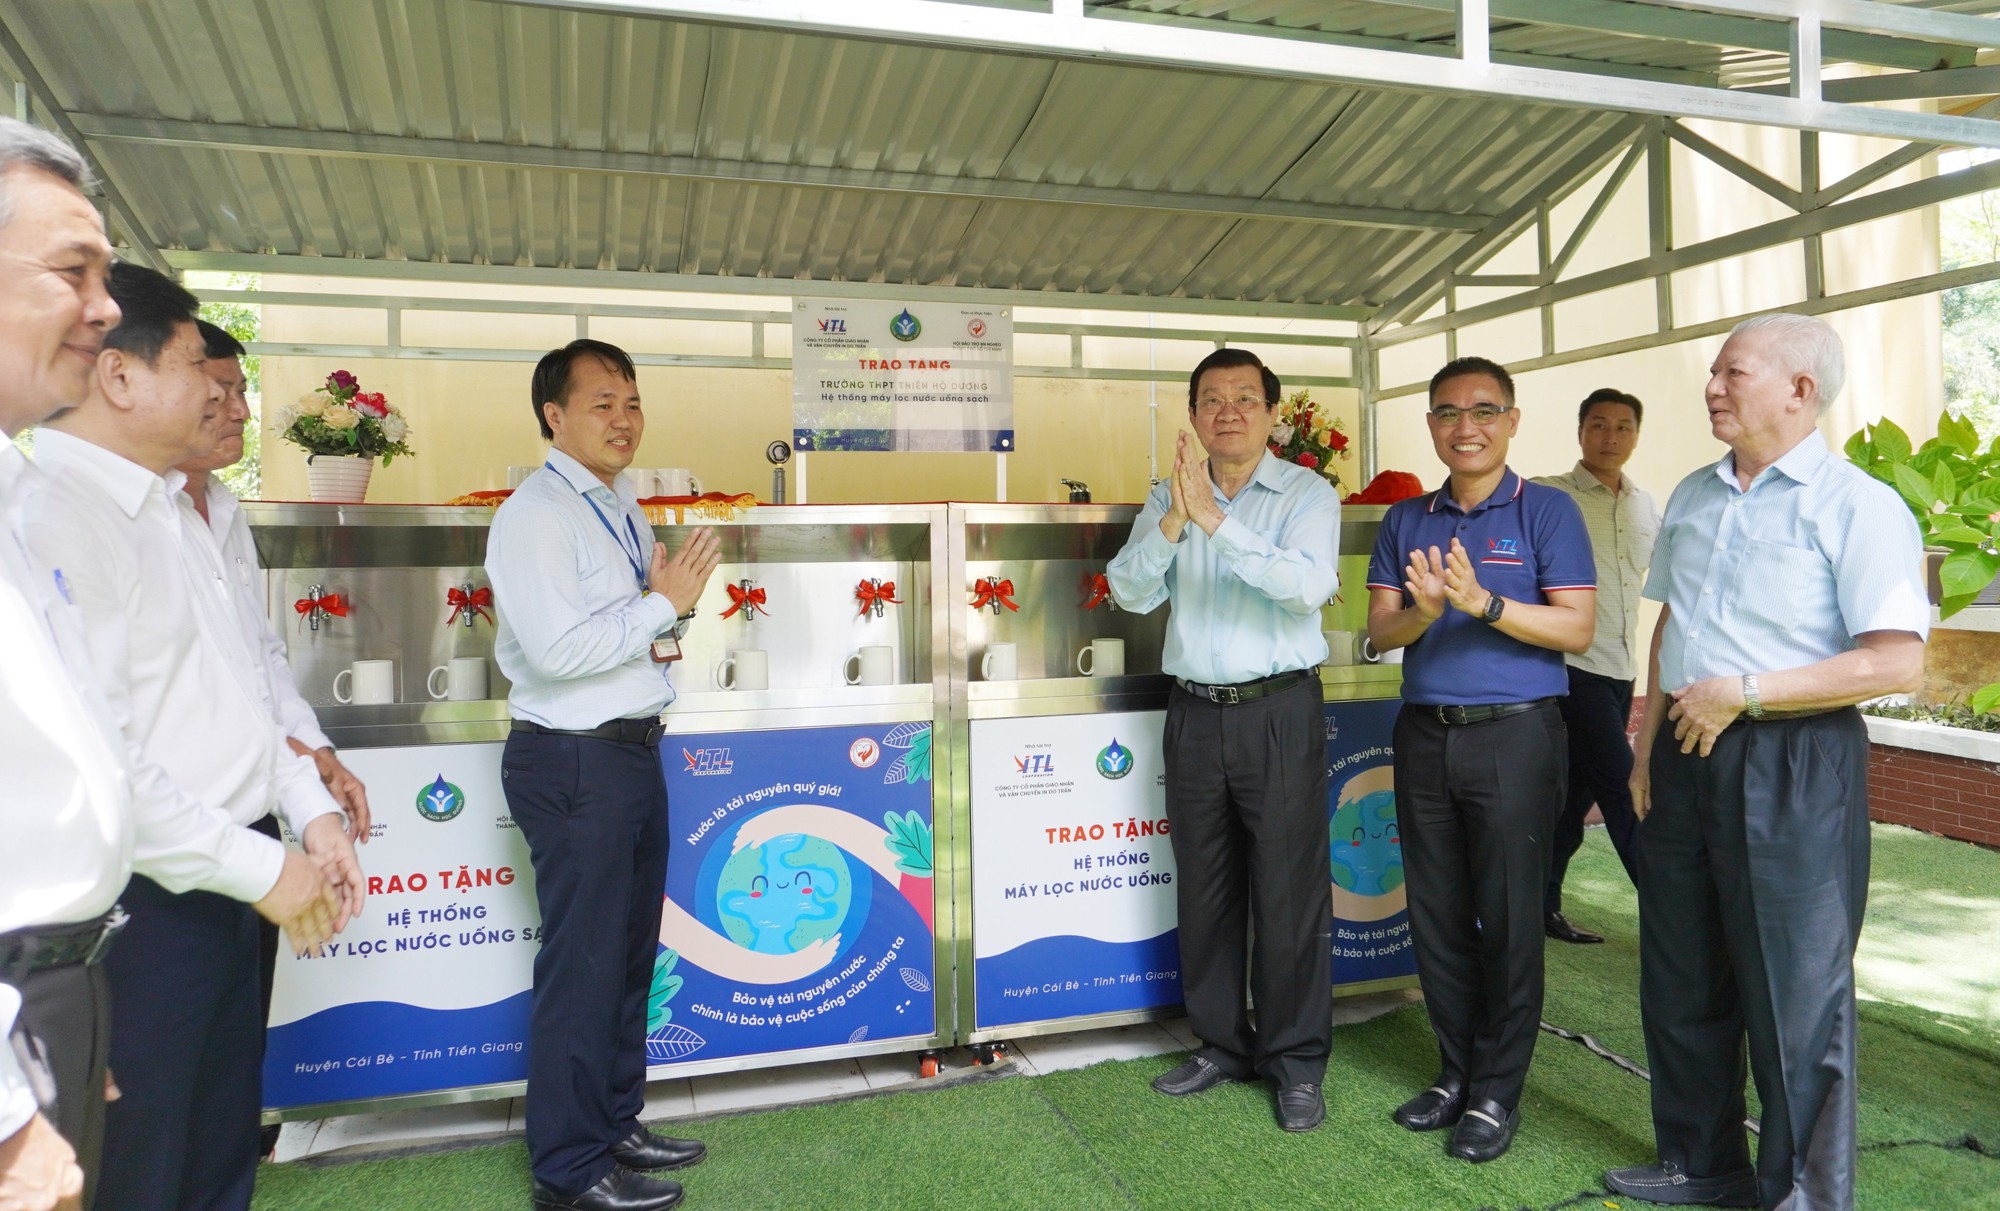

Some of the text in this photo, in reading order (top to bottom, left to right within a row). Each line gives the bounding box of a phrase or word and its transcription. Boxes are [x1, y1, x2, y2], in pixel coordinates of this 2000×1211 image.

[858, 359, 902, 370] TRAO
[821, 393, 834, 402] Hệ
[838, 393, 867, 403] thống
[870, 393, 891, 402] máy
[912, 393, 936, 402] nước
[966, 395, 989, 404] sạch
[869, 381, 894, 389] THPT
[1332, 757, 1347, 771] tài
[1346, 746, 1382, 763] nguyên
[686, 781, 843, 846] Nước là tài nguyên quý giá!
[1045, 817, 1171, 844] TRAO TẶNG
[1074, 849, 1150, 873] HỆ THỐNG
[367, 864, 516, 896] RAO TẶNG
[1005, 870, 1172, 900] MÁY LỌC NƯỚC UỐNG
[387, 902, 487, 929] HỆ THỐNG
[347, 939, 388, 959] LỌC
[395, 931, 452, 952] NƯỚC
[459, 925, 516, 946] UỐNG
[522, 926, 543, 944] SẠ
[1337, 920, 1410, 943] Bảo vệ tài nguy
[1331, 934, 1413, 960] là bảo vệ cuộc số
[691, 935, 906, 1028] chính là bảo vệ cuộc sống của chúng ta
[732, 953, 867, 1009] Bảo vệ tài nguyên nước
[1003, 985, 1039, 998] Huyện
[1042, 981, 1062, 993] Cái
[1065, 980, 1080, 991] Bè
[1093, 977, 1116, 988] Tỉnh
[1119, 973, 1142, 984] Tiền
[1145, 970, 1178, 981] Giang
[294, 1059, 341, 1074] Huyện
[346, 1054, 371, 1068] Cái
[376, 1052, 395, 1066] Bè
[413, 1048, 442, 1061] Tỉnh
[447, 1044, 477, 1057] Tiền
[481, 1040, 524, 1054] Giang
